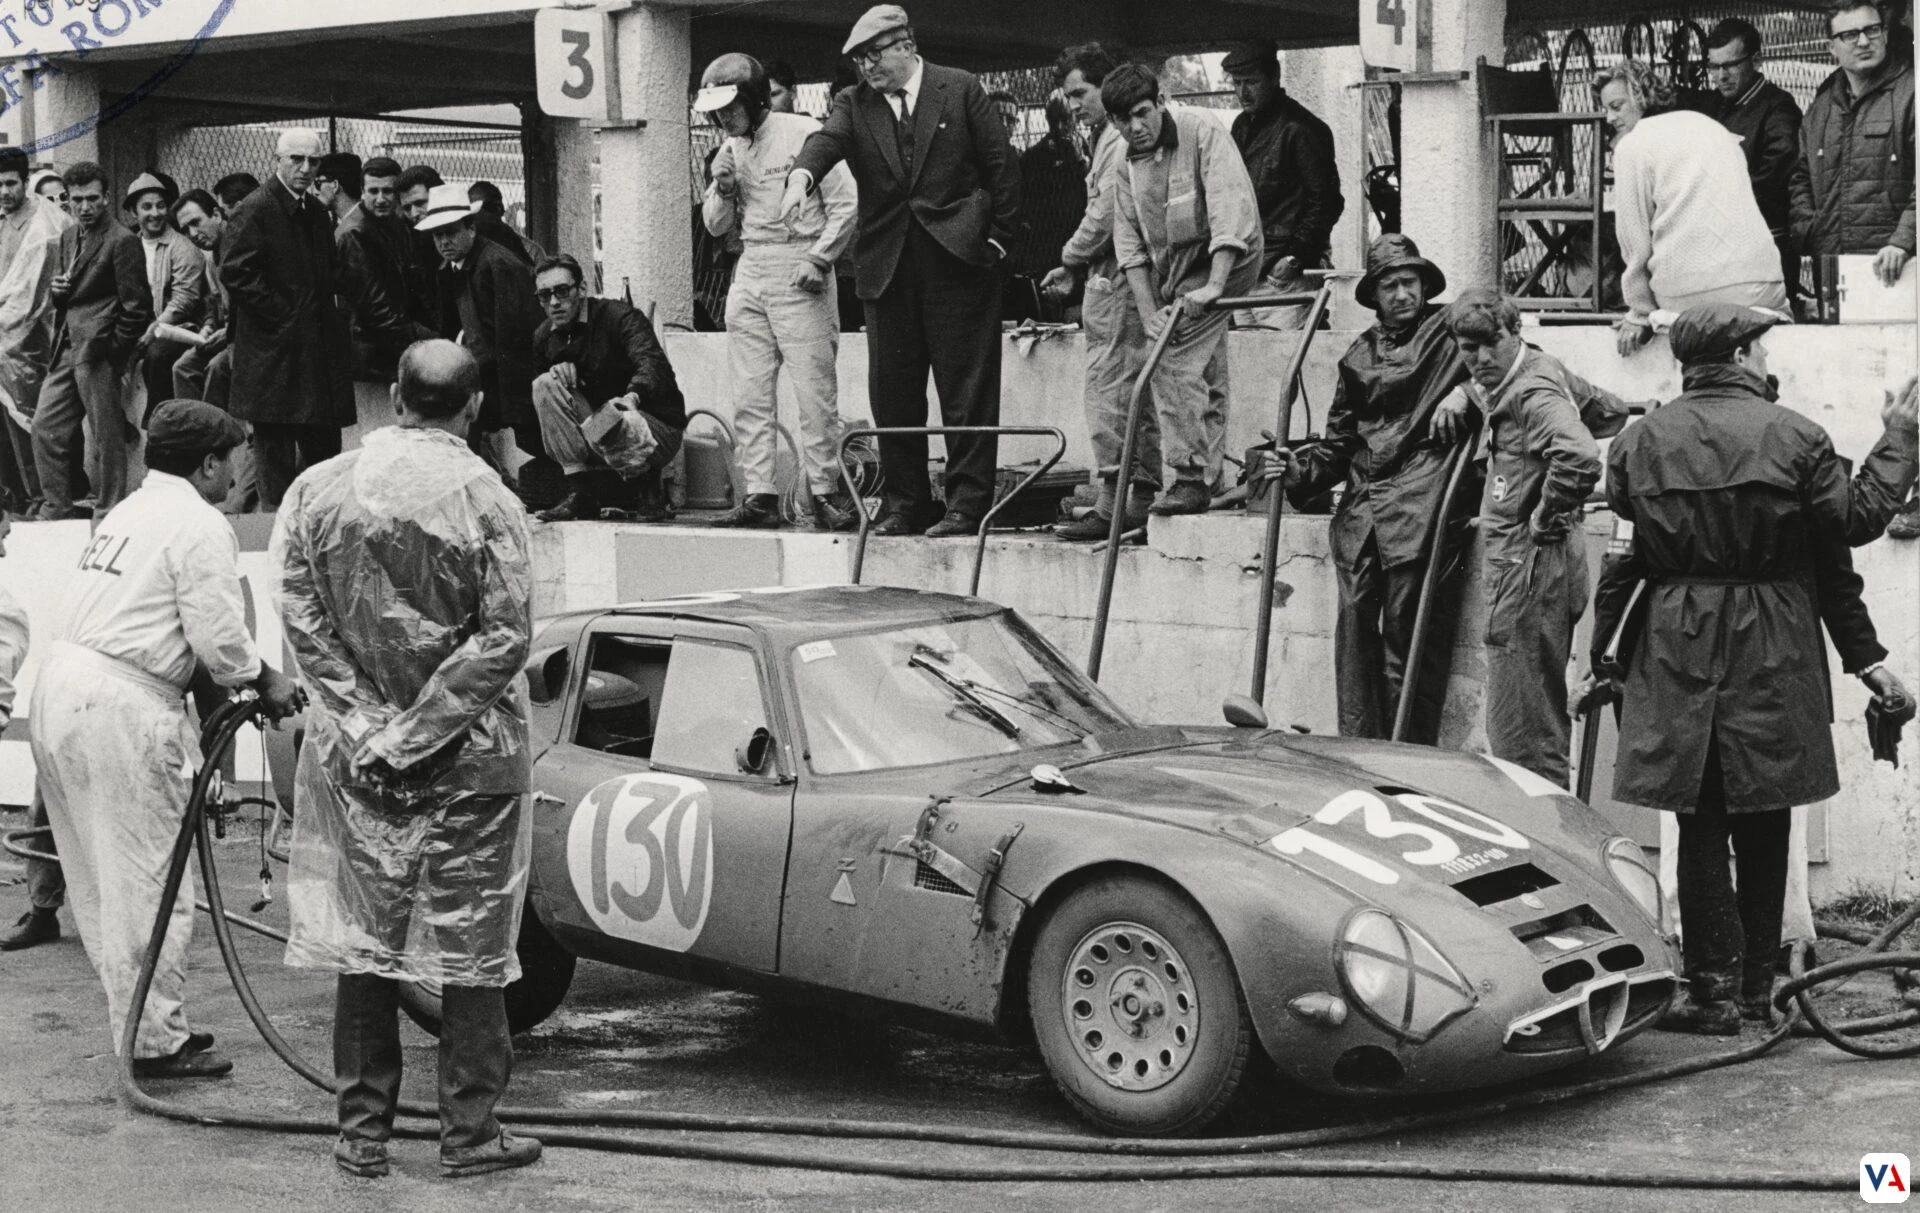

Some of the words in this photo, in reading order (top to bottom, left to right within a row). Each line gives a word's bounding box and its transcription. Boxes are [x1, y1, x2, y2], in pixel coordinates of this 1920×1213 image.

[1377, 0, 1405, 45] 4
[561, 29, 593, 99] 3
[590, 778, 712, 930] 130
[1273, 790, 1530, 884] 130
